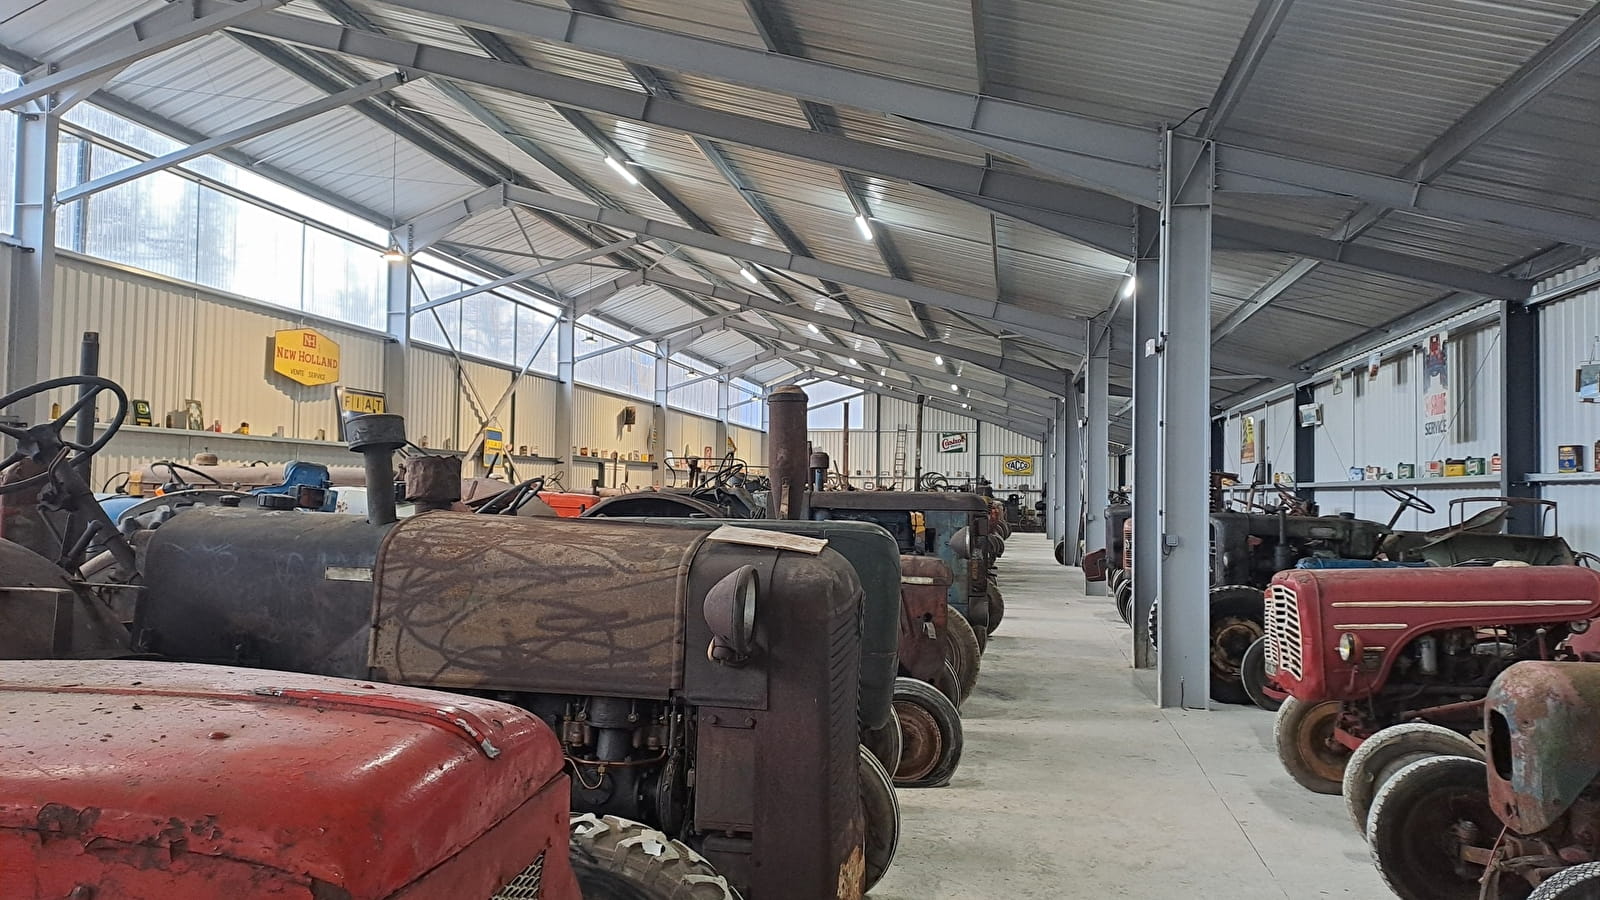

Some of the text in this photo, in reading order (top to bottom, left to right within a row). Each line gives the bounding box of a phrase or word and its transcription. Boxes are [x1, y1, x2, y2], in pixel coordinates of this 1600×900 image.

[276, 346, 338, 369] NEW HOLLAND
[308, 371, 326, 381] SERVICE
[344, 395, 382, 412] FIAT
[1424, 420, 1447, 436] SERVICE
